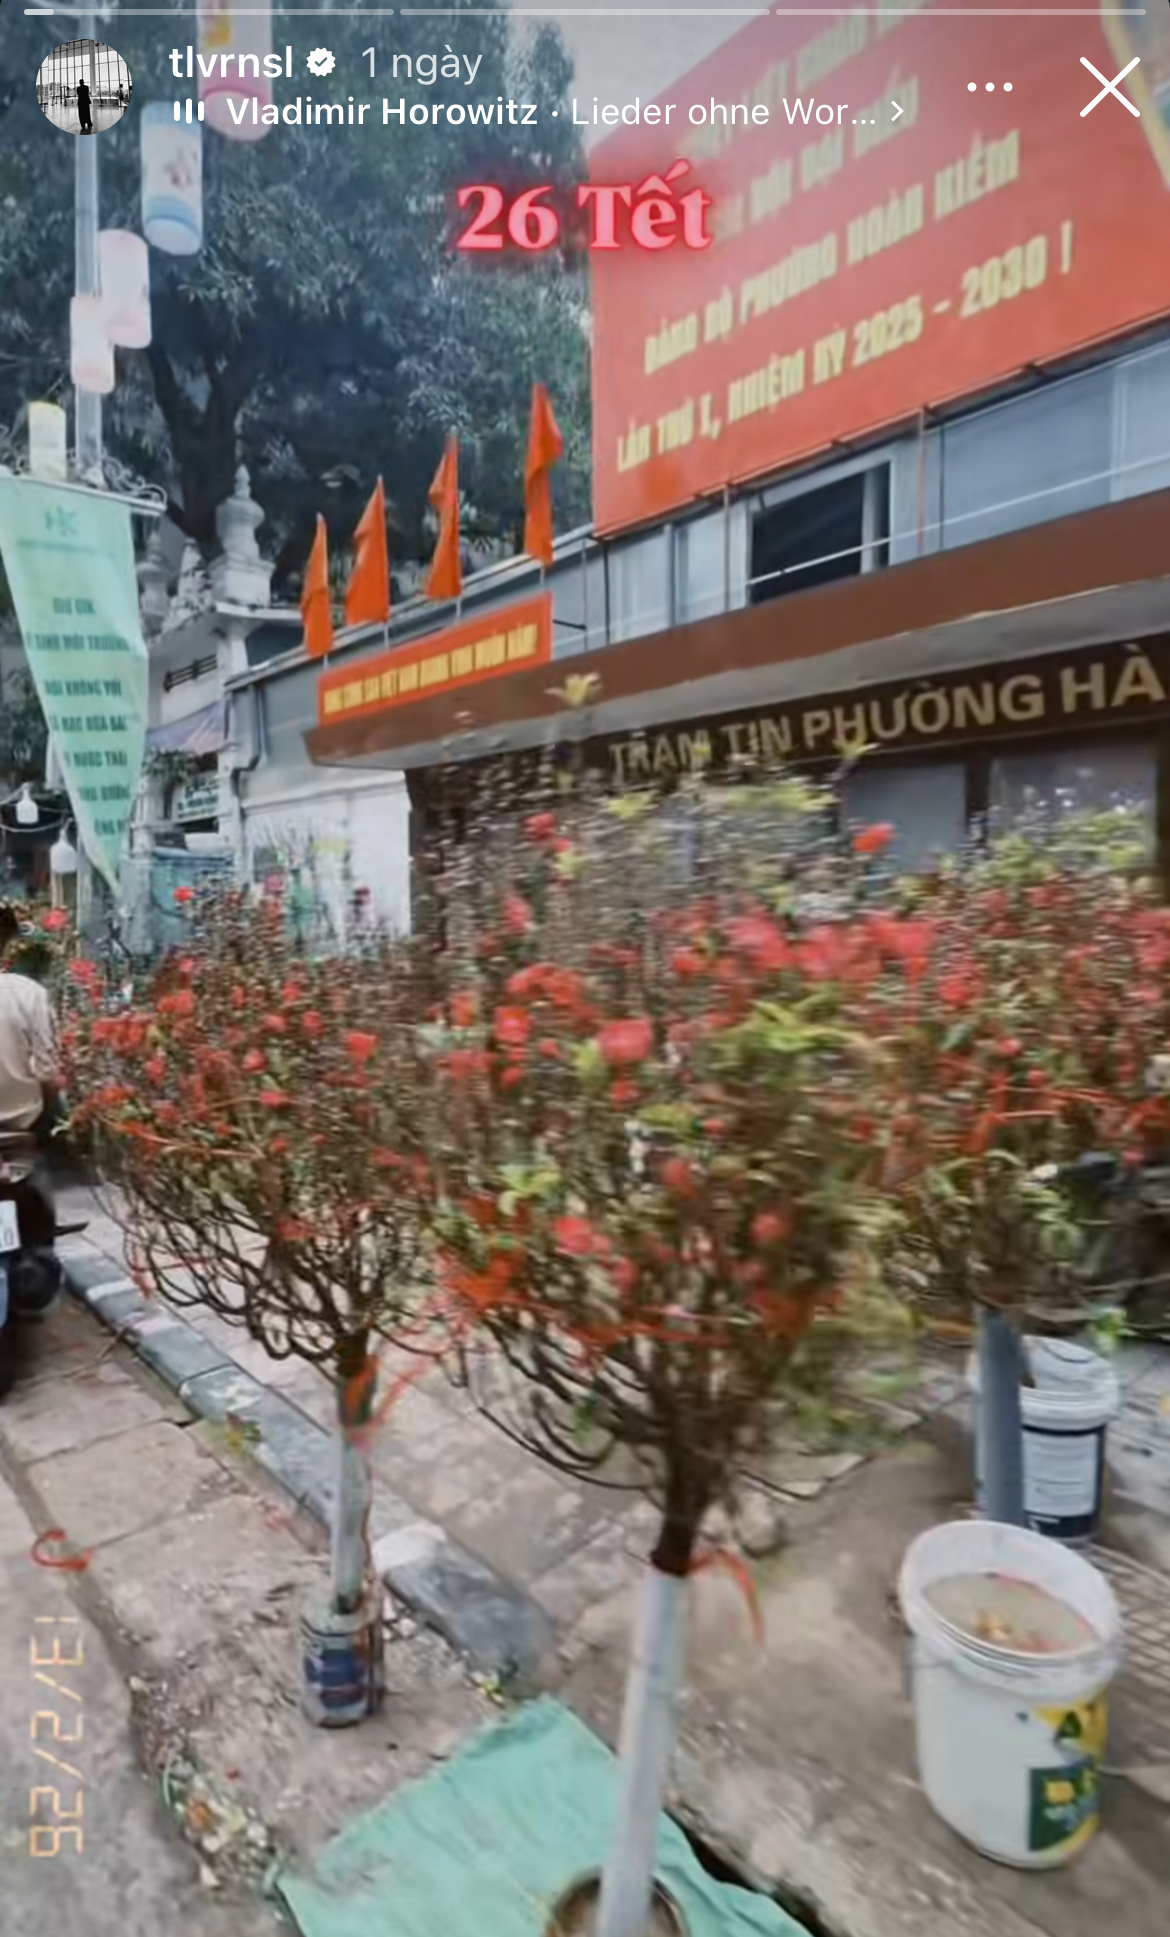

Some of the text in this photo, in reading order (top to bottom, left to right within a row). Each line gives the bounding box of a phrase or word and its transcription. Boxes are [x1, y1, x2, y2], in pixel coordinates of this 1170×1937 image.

[852, 295, 924, 368] 2025
[959, 234, 1048, 319] 2030
[802, 674, 1046, 751] PHƯỜNG
